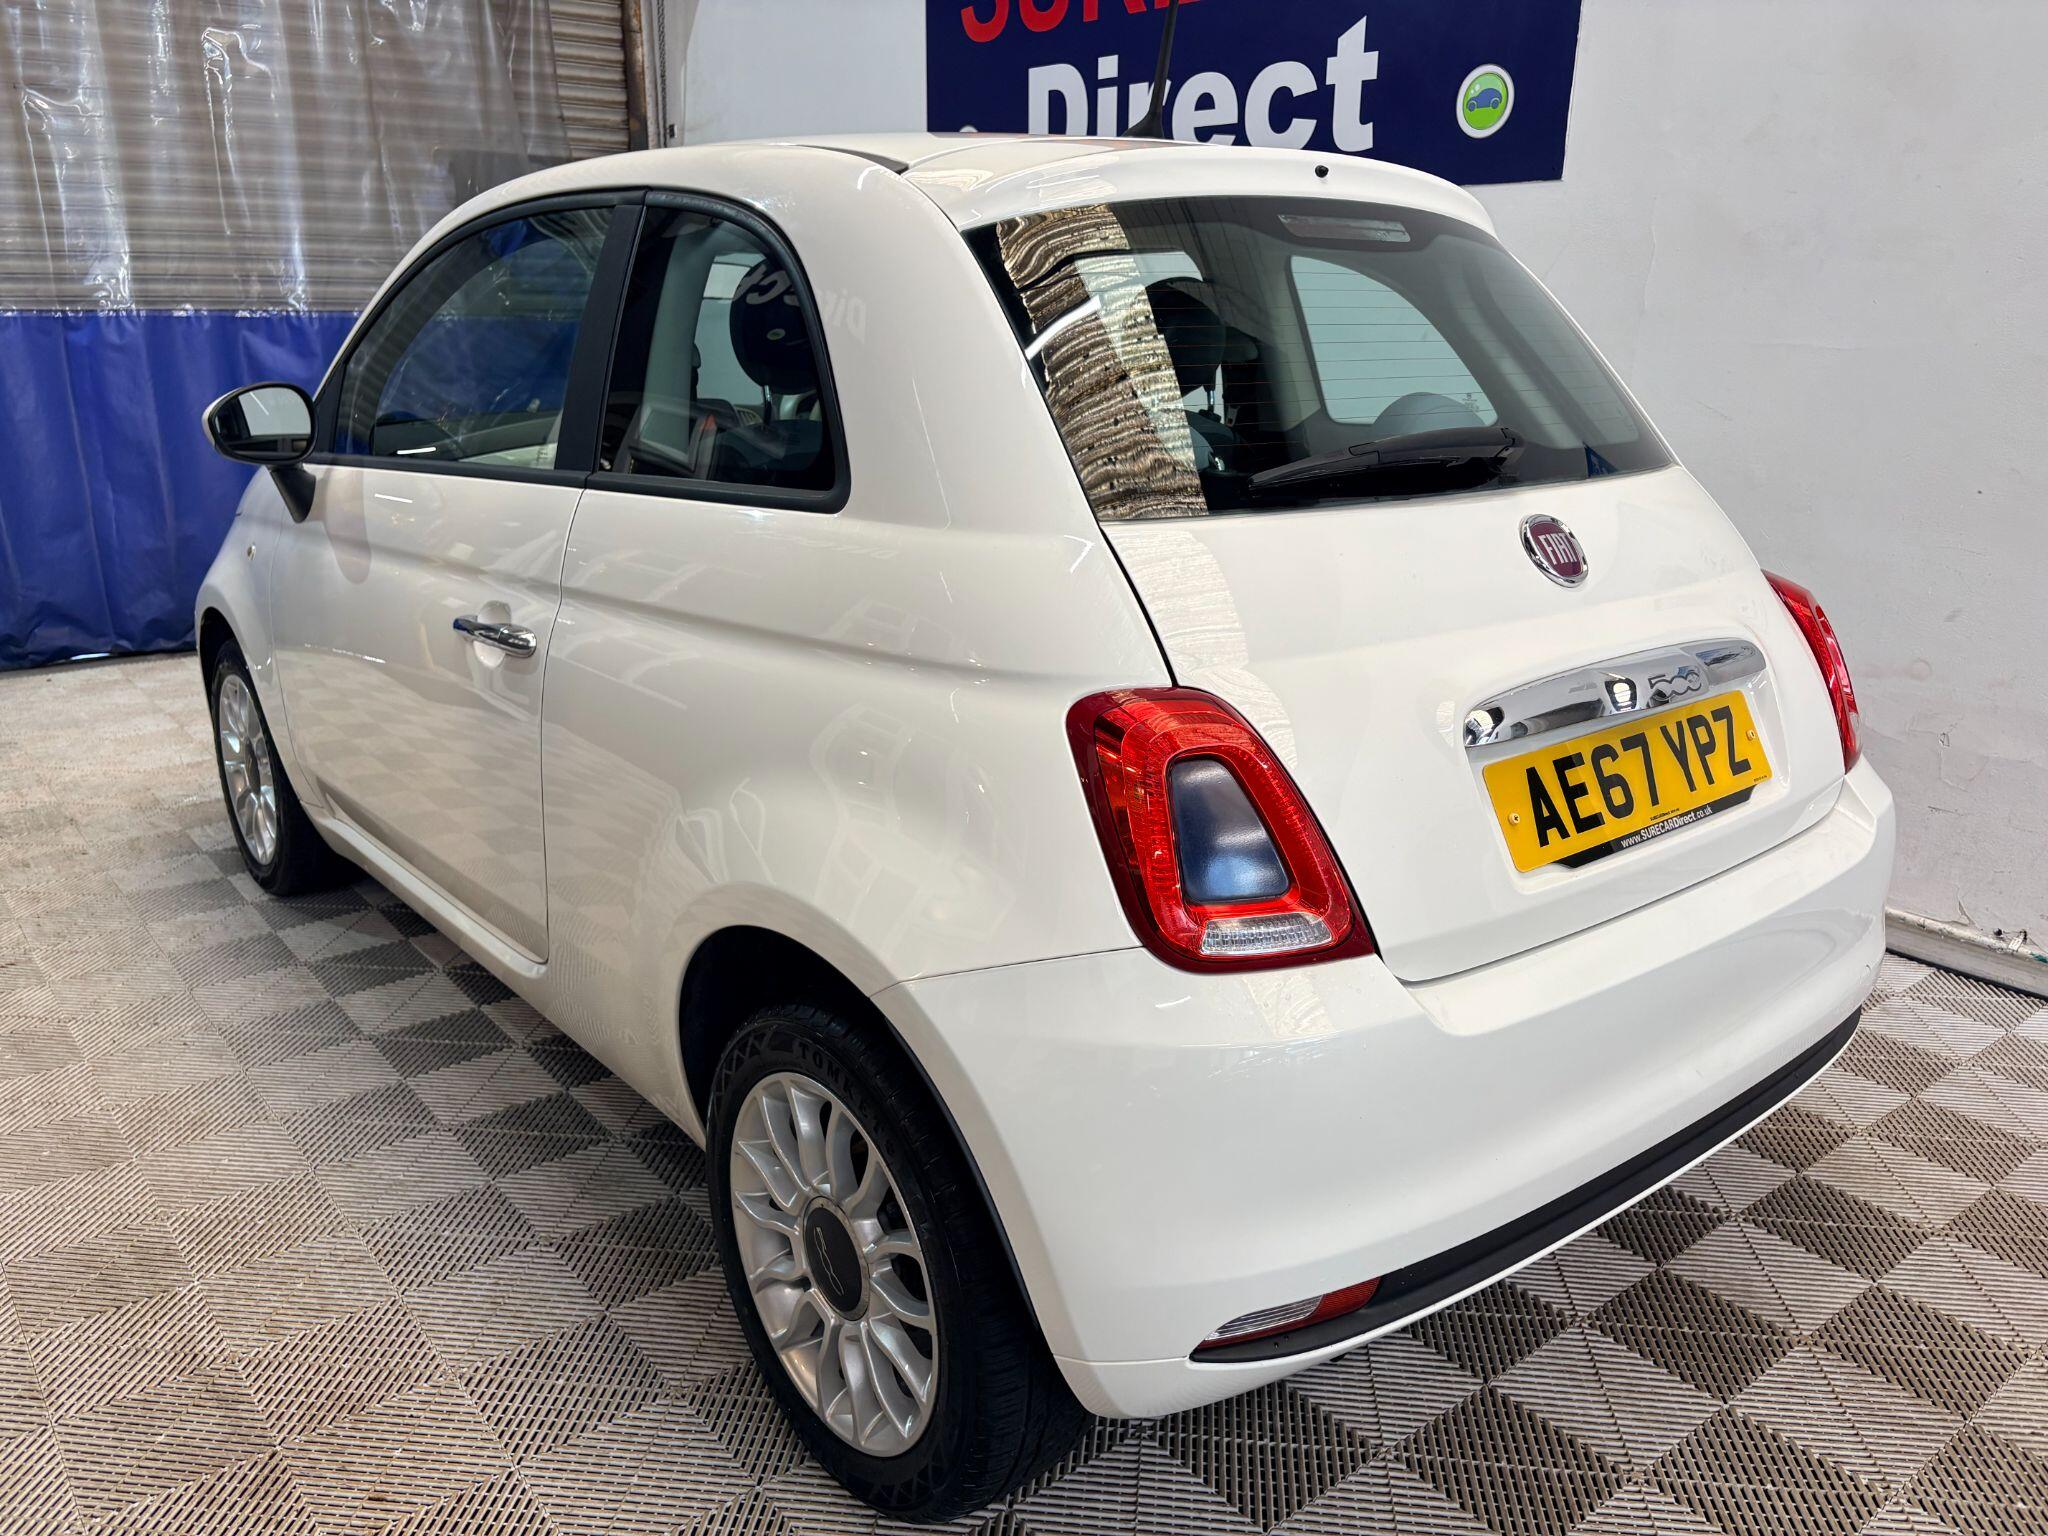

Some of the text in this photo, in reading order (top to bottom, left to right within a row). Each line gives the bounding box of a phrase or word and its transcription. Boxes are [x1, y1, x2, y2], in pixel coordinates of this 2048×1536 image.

[1027, 15, 1380, 152] Direct
[1538, 532, 1578, 565] FIAT
[1648, 671, 1702, 700] 500
[1525, 705, 1752, 848] AE67 YPZ
